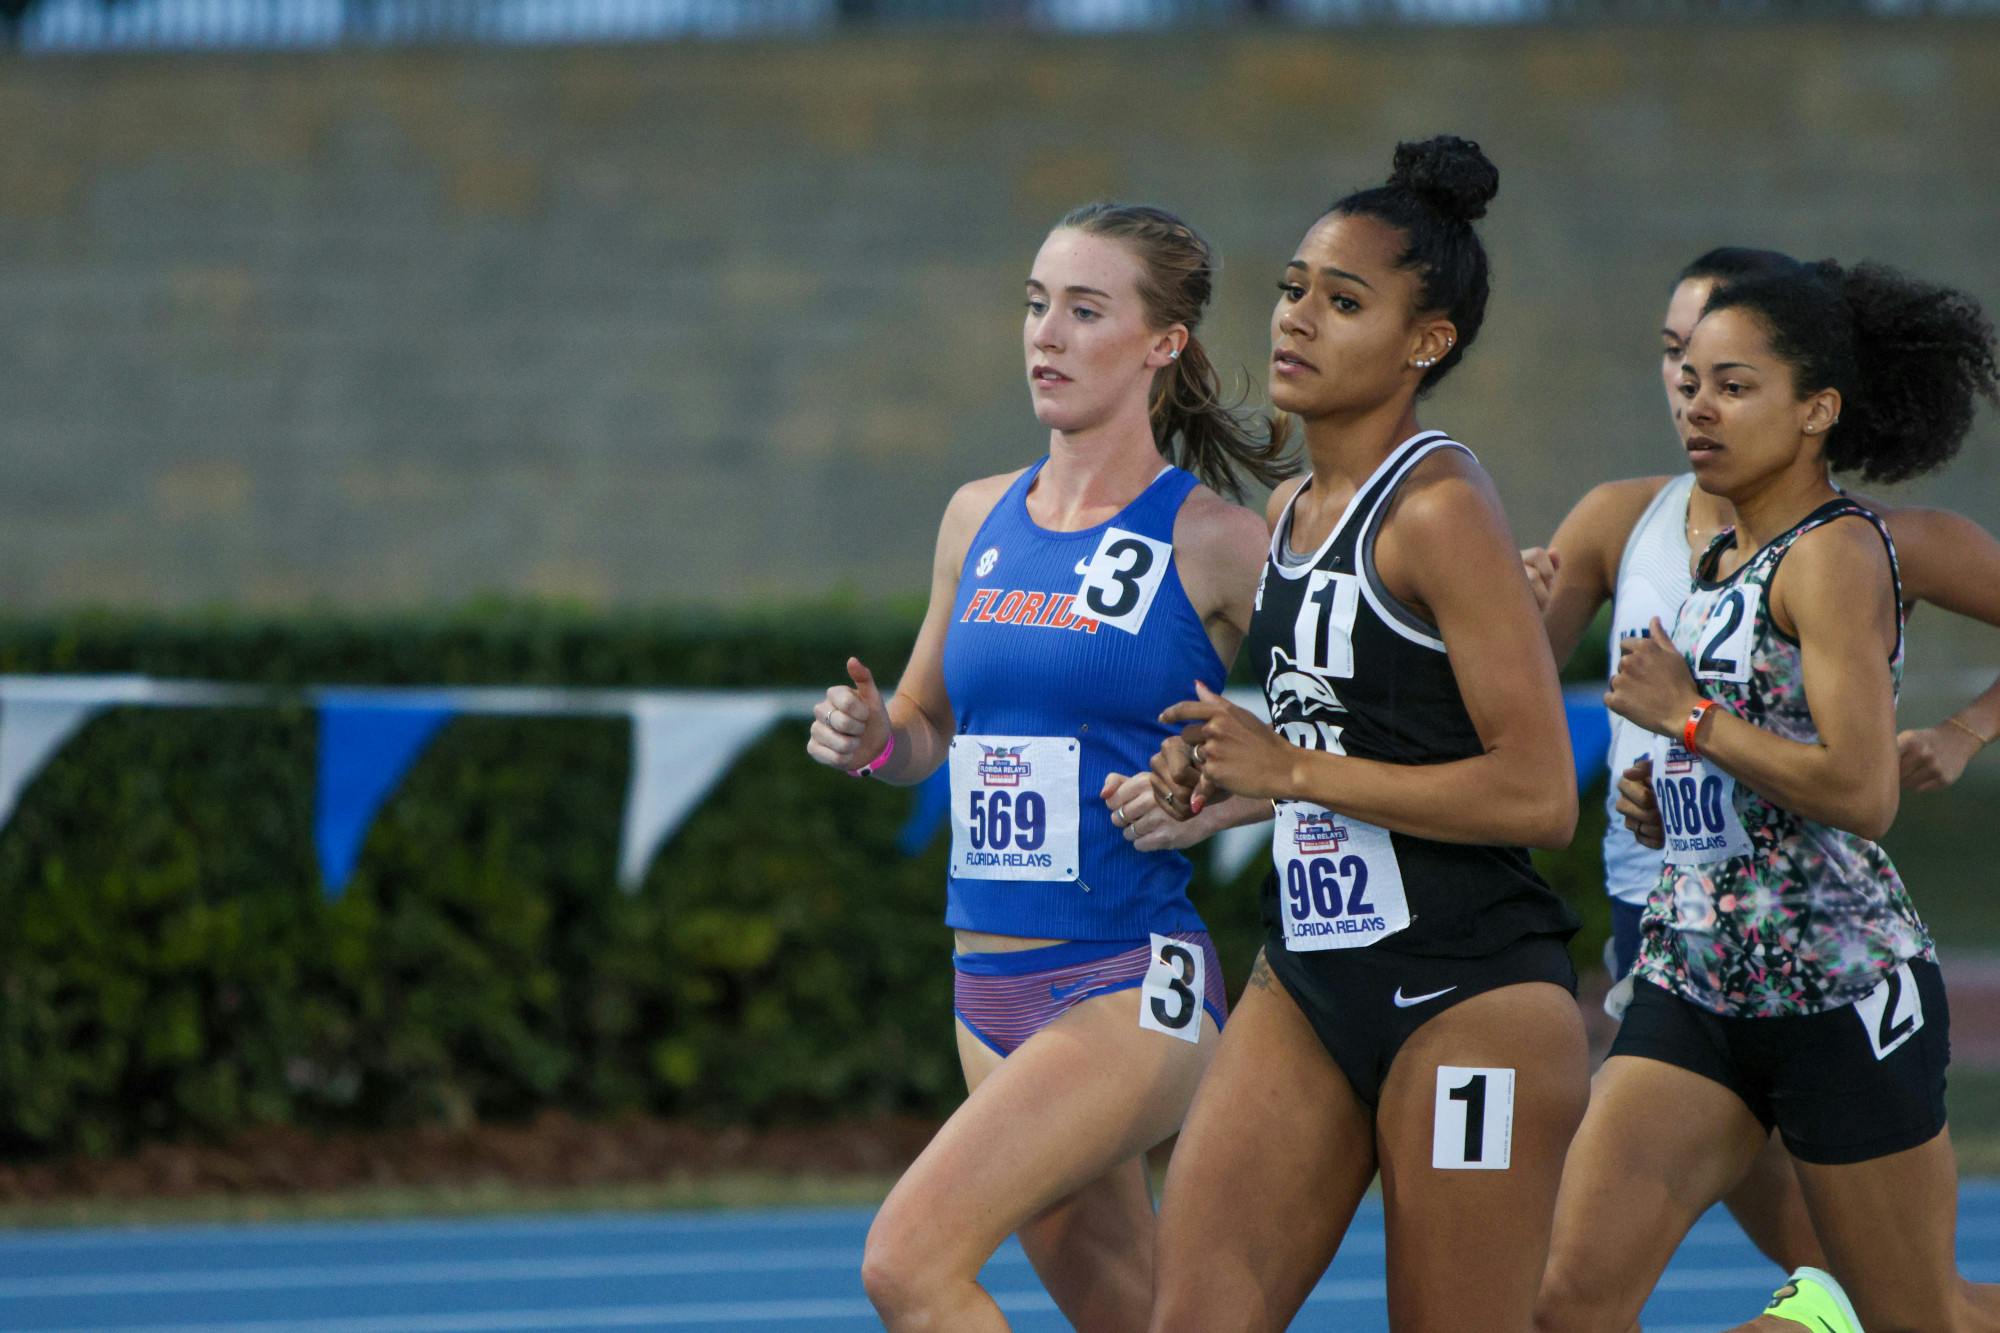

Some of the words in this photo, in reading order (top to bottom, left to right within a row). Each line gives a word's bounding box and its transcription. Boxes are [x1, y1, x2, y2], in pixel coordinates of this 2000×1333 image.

[1086, 538, 1154, 617] 3
[1310, 578, 1338, 669] 1
[1698, 590, 1745, 674] 2
[966, 852, 1001, 867] FLORIDA
[1003, 853, 1052, 868] RELAYS
[970, 790, 1046, 851] 569
[1689, 835, 1728, 851] RELAYS
[1287, 855, 1375, 921] 962
[1336, 917, 1386, 935] RELAYS
[1150, 944, 1196, 1030] 3
[1860, 969, 1915, 1050] 2
[1449, 1074, 1487, 1162] 1
